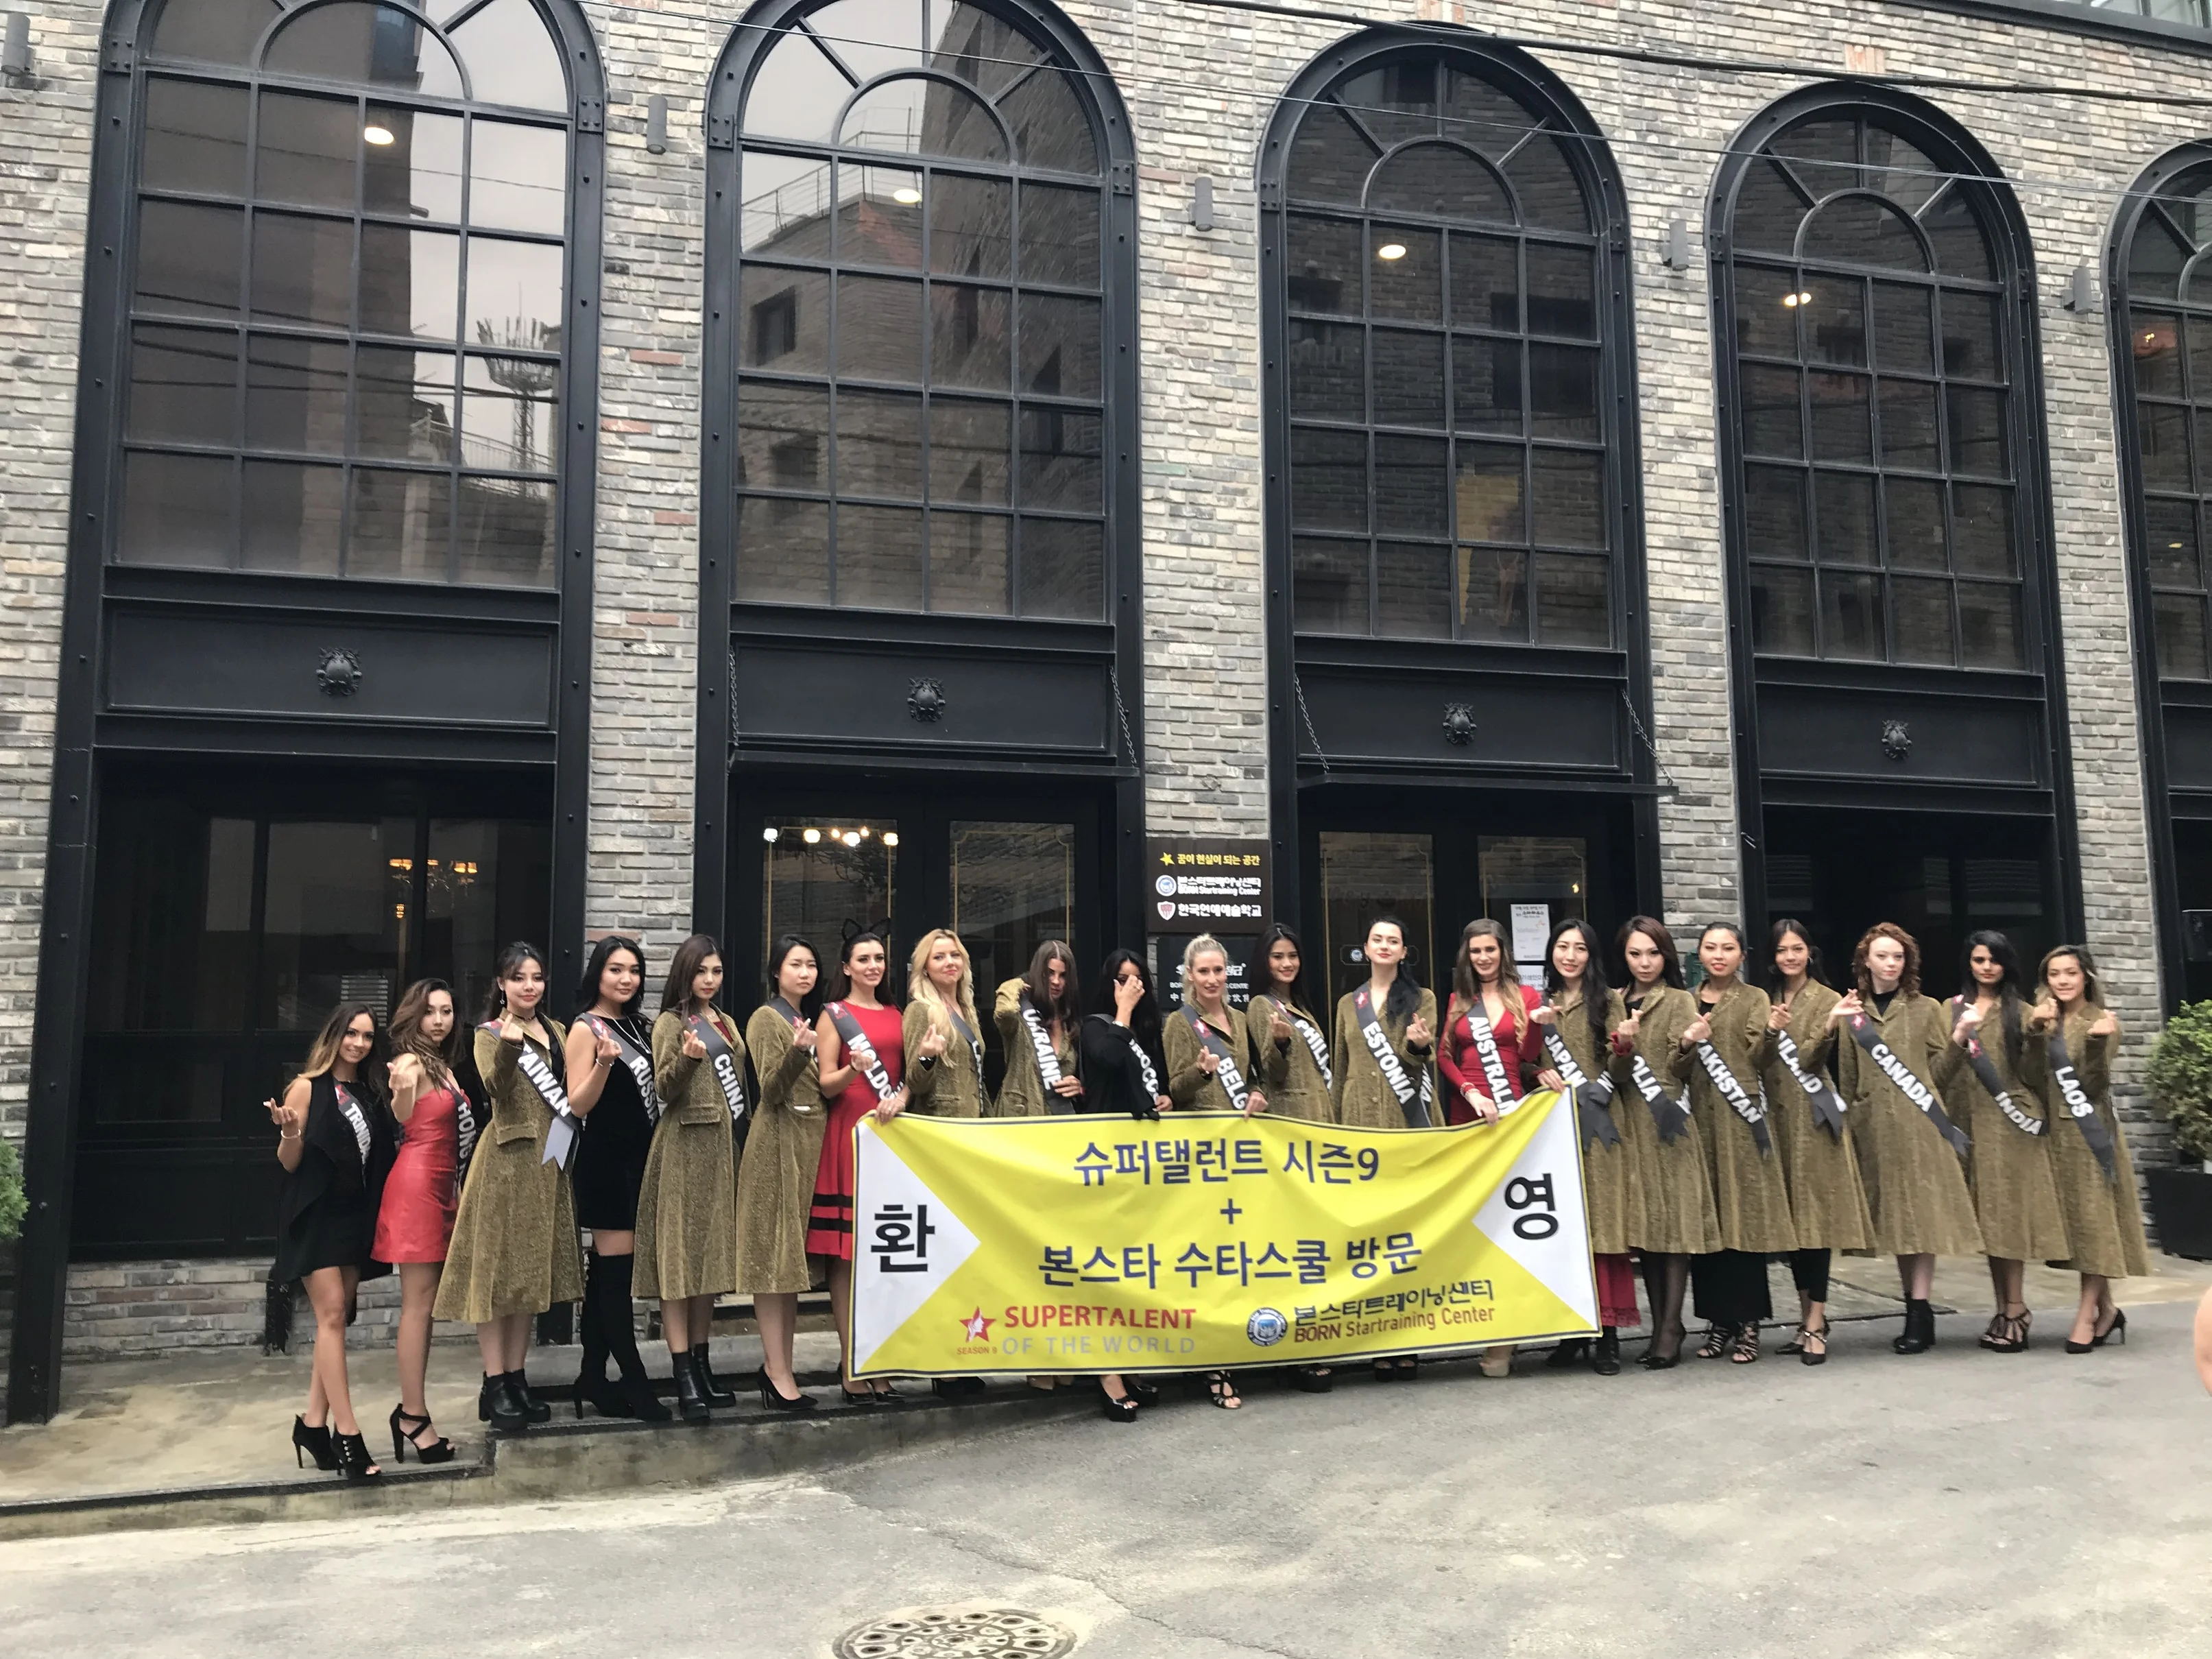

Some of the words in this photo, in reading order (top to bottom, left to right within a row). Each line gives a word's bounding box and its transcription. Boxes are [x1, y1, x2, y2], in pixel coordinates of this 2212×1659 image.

[1177, 853, 1195, 865] 꿈이
[1196, 853, 1222, 866] 현실이
[1223, 854, 1241, 866] 되는
[1242, 855, 1261, 866] 공간
[1238, 887, 1262, 895] Center
[714, 1053, 745, 1120] CHINA
[1362, 1021, 1415, 1104] ESTONIA
[1544, 1034, 1588, 1088] JAPAN
[1697, 1039, 1762, 1123] AKHSTAN
[1871, 1043, 1935, 1112] CANADA
[1995, 1092, 2043, 1136] INDIA
[2056, 1066, 2094, 1117] LAOS
[1074, 1138, 1267, 1186] 슈퍼탤런트
[1283, 1140, 1379, 1184] 시즌9
[1504, 1173, 1559, 1240] 영
[870, 1204, 935, 1273] 환
[1039, 1243, 1161, 1289] 본스타
[1174, 1240, 1330, 1287] 수타스쿨
[1347, 1232, 1421, 1278] 방문
[1004, 1304, 1197, 1329] SUPERTALENT
[1294, 1323, 1342, 1343] BORN
[1345, 1311, 1436, 1337] Startraining
[1441, 1305, 1495, 1326] Center
[957, 1346, 989, 1355] SEASON
[1002, 1337, 1034, 1355] OF
[1044, 1335, 1092, 1354] THE
[1102, 1335, 1196, 1354] WORLD
